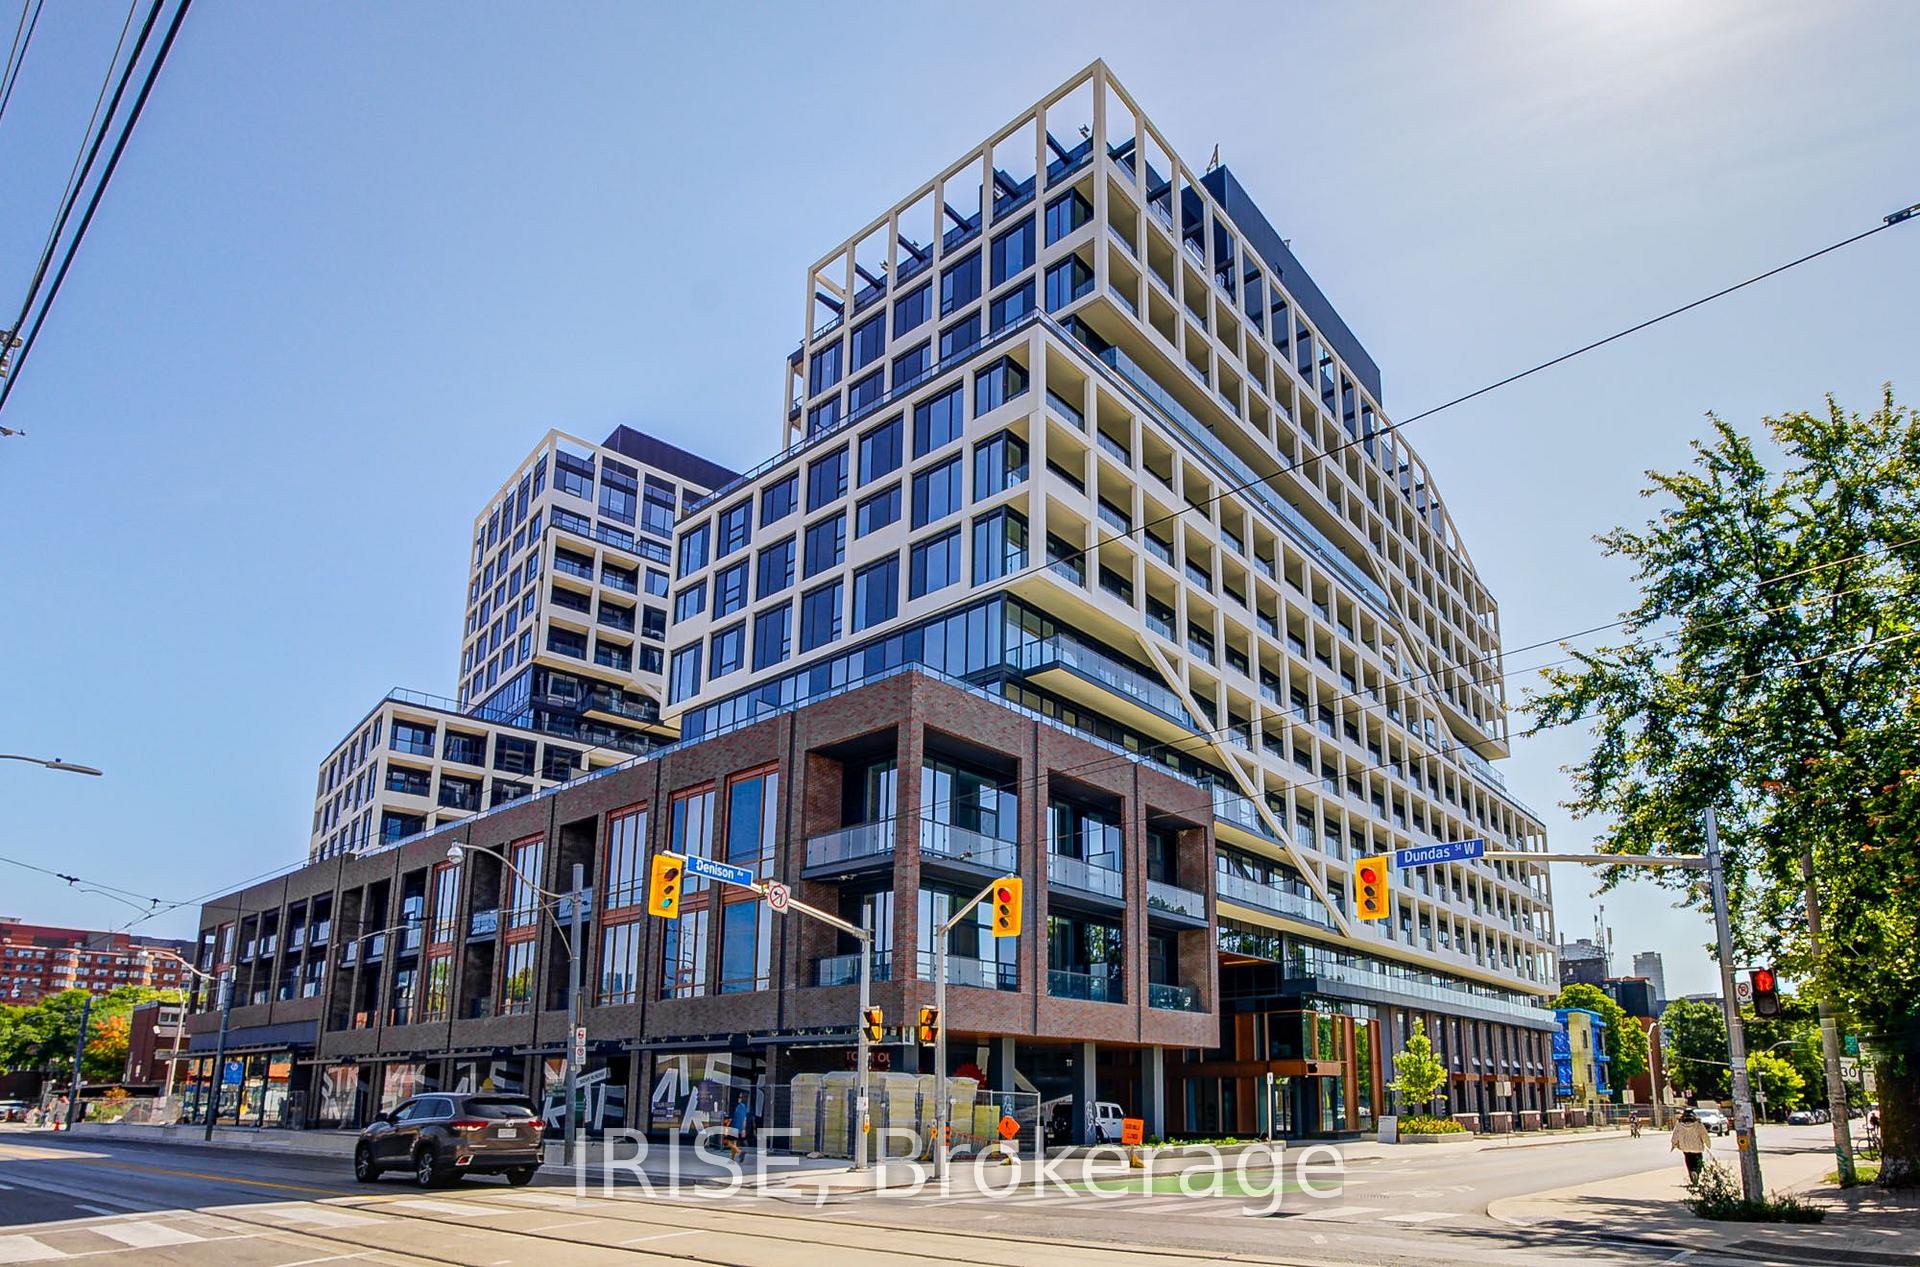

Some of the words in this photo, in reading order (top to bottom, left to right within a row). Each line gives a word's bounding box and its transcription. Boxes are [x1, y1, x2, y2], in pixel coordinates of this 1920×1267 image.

[1404, 847, 1450, 863] Dundas
[1454, 843, 1462, 852] St
[1464, 842, 1475, 855] W
[696, 860, 734, 879] Denison
[1840, 1066, 1857, 1078] 30
